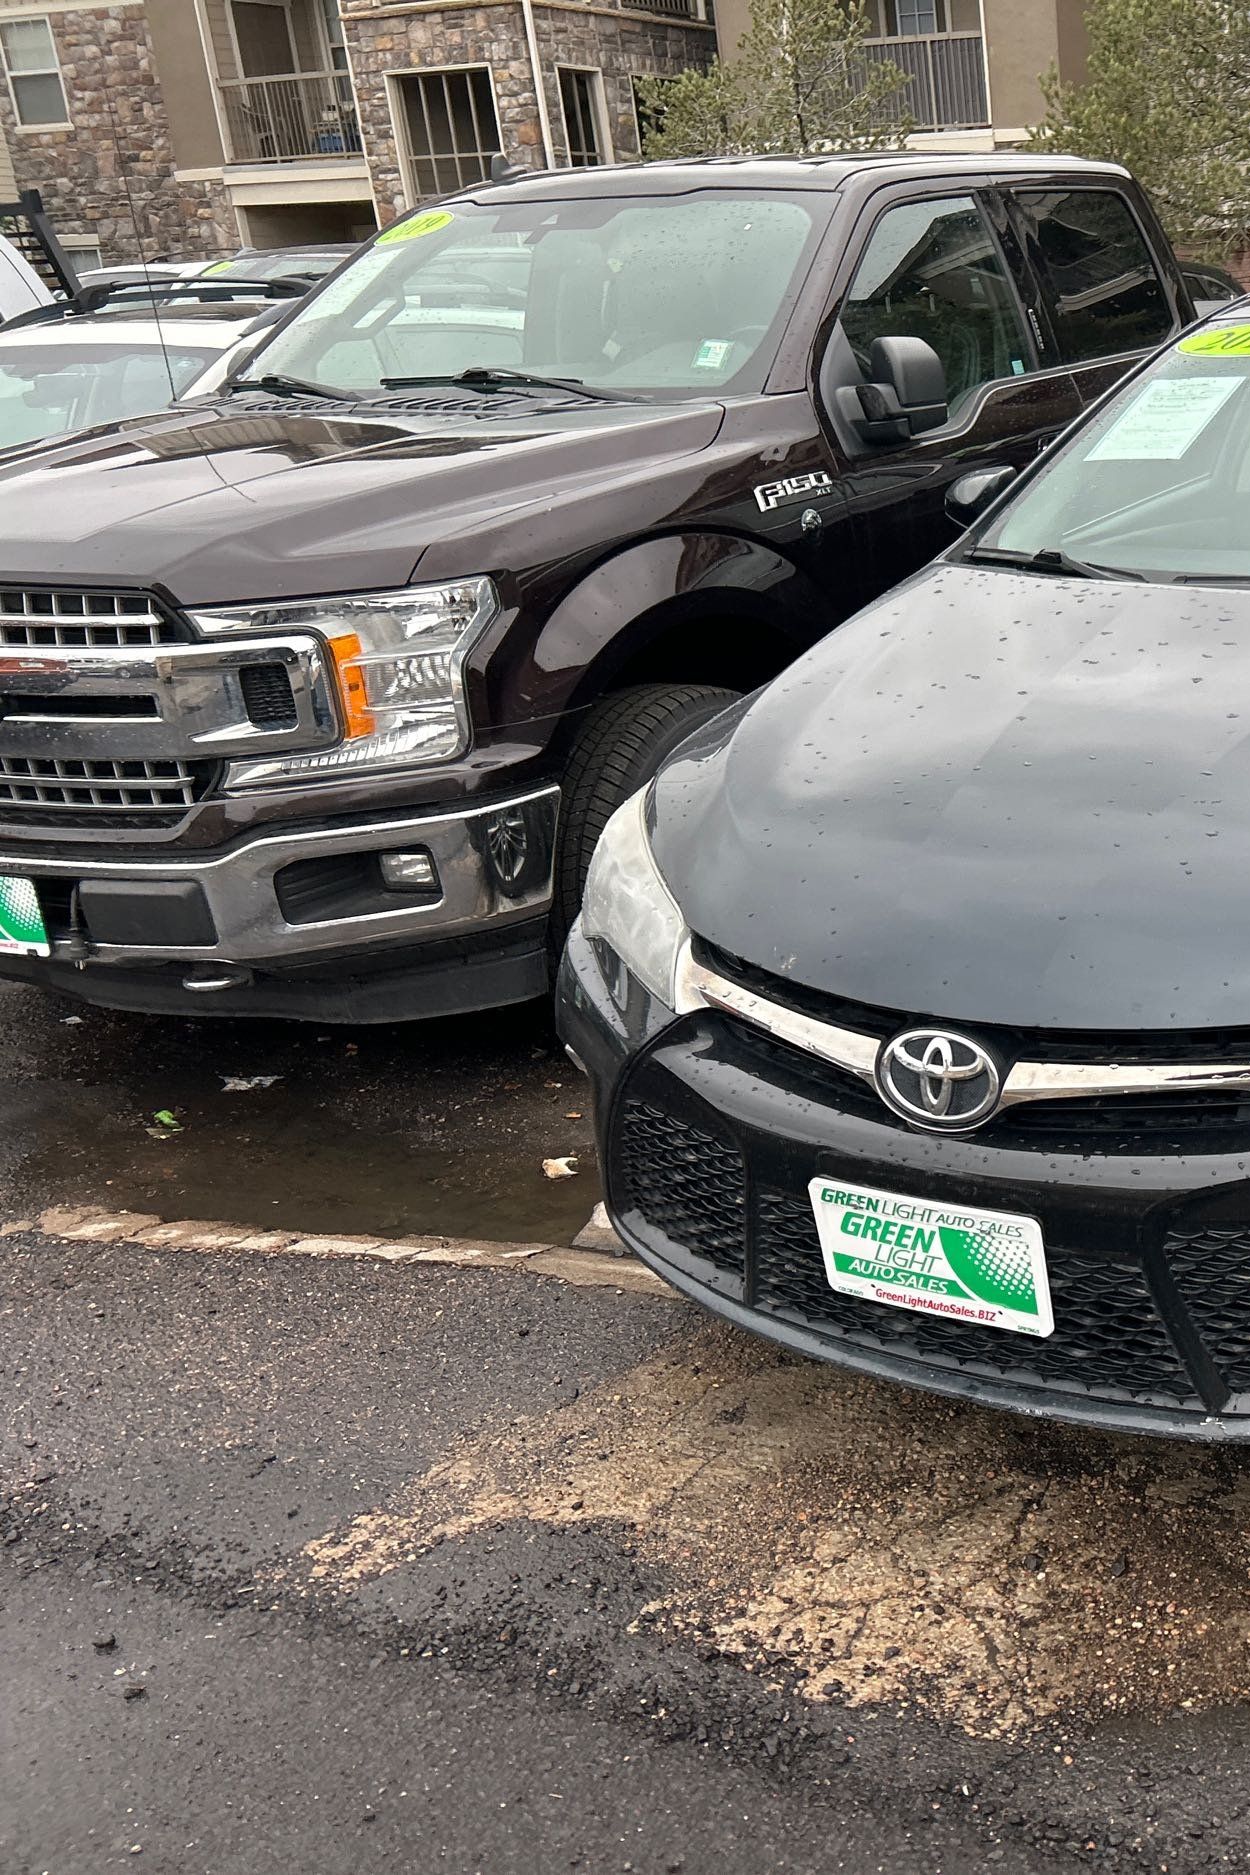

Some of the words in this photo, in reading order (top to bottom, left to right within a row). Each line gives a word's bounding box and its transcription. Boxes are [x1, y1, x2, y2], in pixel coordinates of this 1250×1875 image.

[816, 487, 832, 497] XLT
[821, 1187, 880, 1213] GREEN
[882, 1200, 938, 1223] LIGHT
[936, 1213, 975, 1229] AUTO
[977, 1220, 1023, 1238] SALES
[840, 1211, 937, 1254] GREEN
[848, 1258, 895, 1279] AUTO
[893, 1271, 949, 1294] SALES
[874, 1244, 943, 1274] LIGHT
[876, 1288, 997, 1322] GreenLightAutoSales.BIZ
